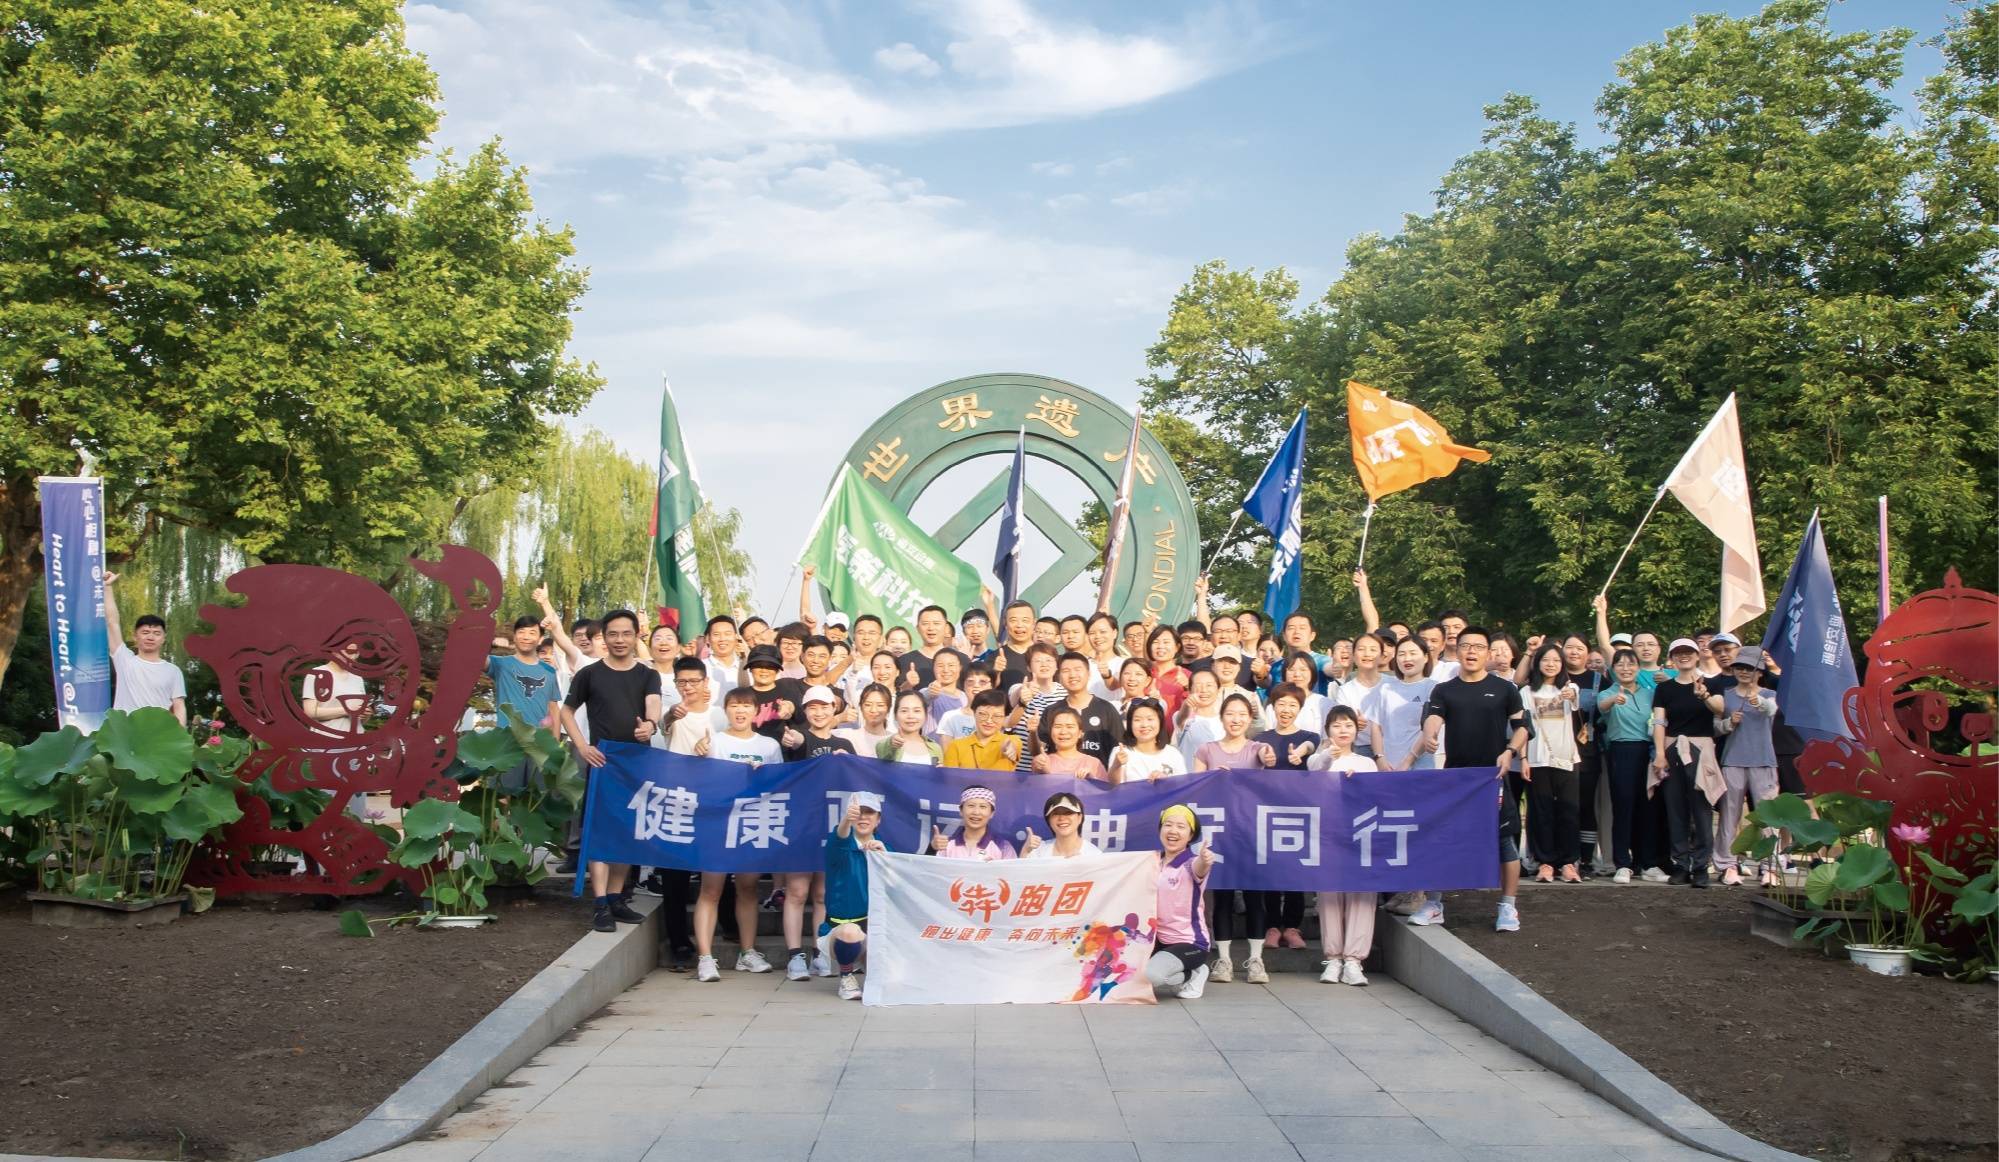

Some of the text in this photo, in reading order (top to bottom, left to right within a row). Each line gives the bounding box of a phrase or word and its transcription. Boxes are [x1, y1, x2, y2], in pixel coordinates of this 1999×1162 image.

[52, 533, 65, 587] Heart
[54, 593, 66, 613] to
[920, 924, 1081, 943] 跑出健康 奔向未来
